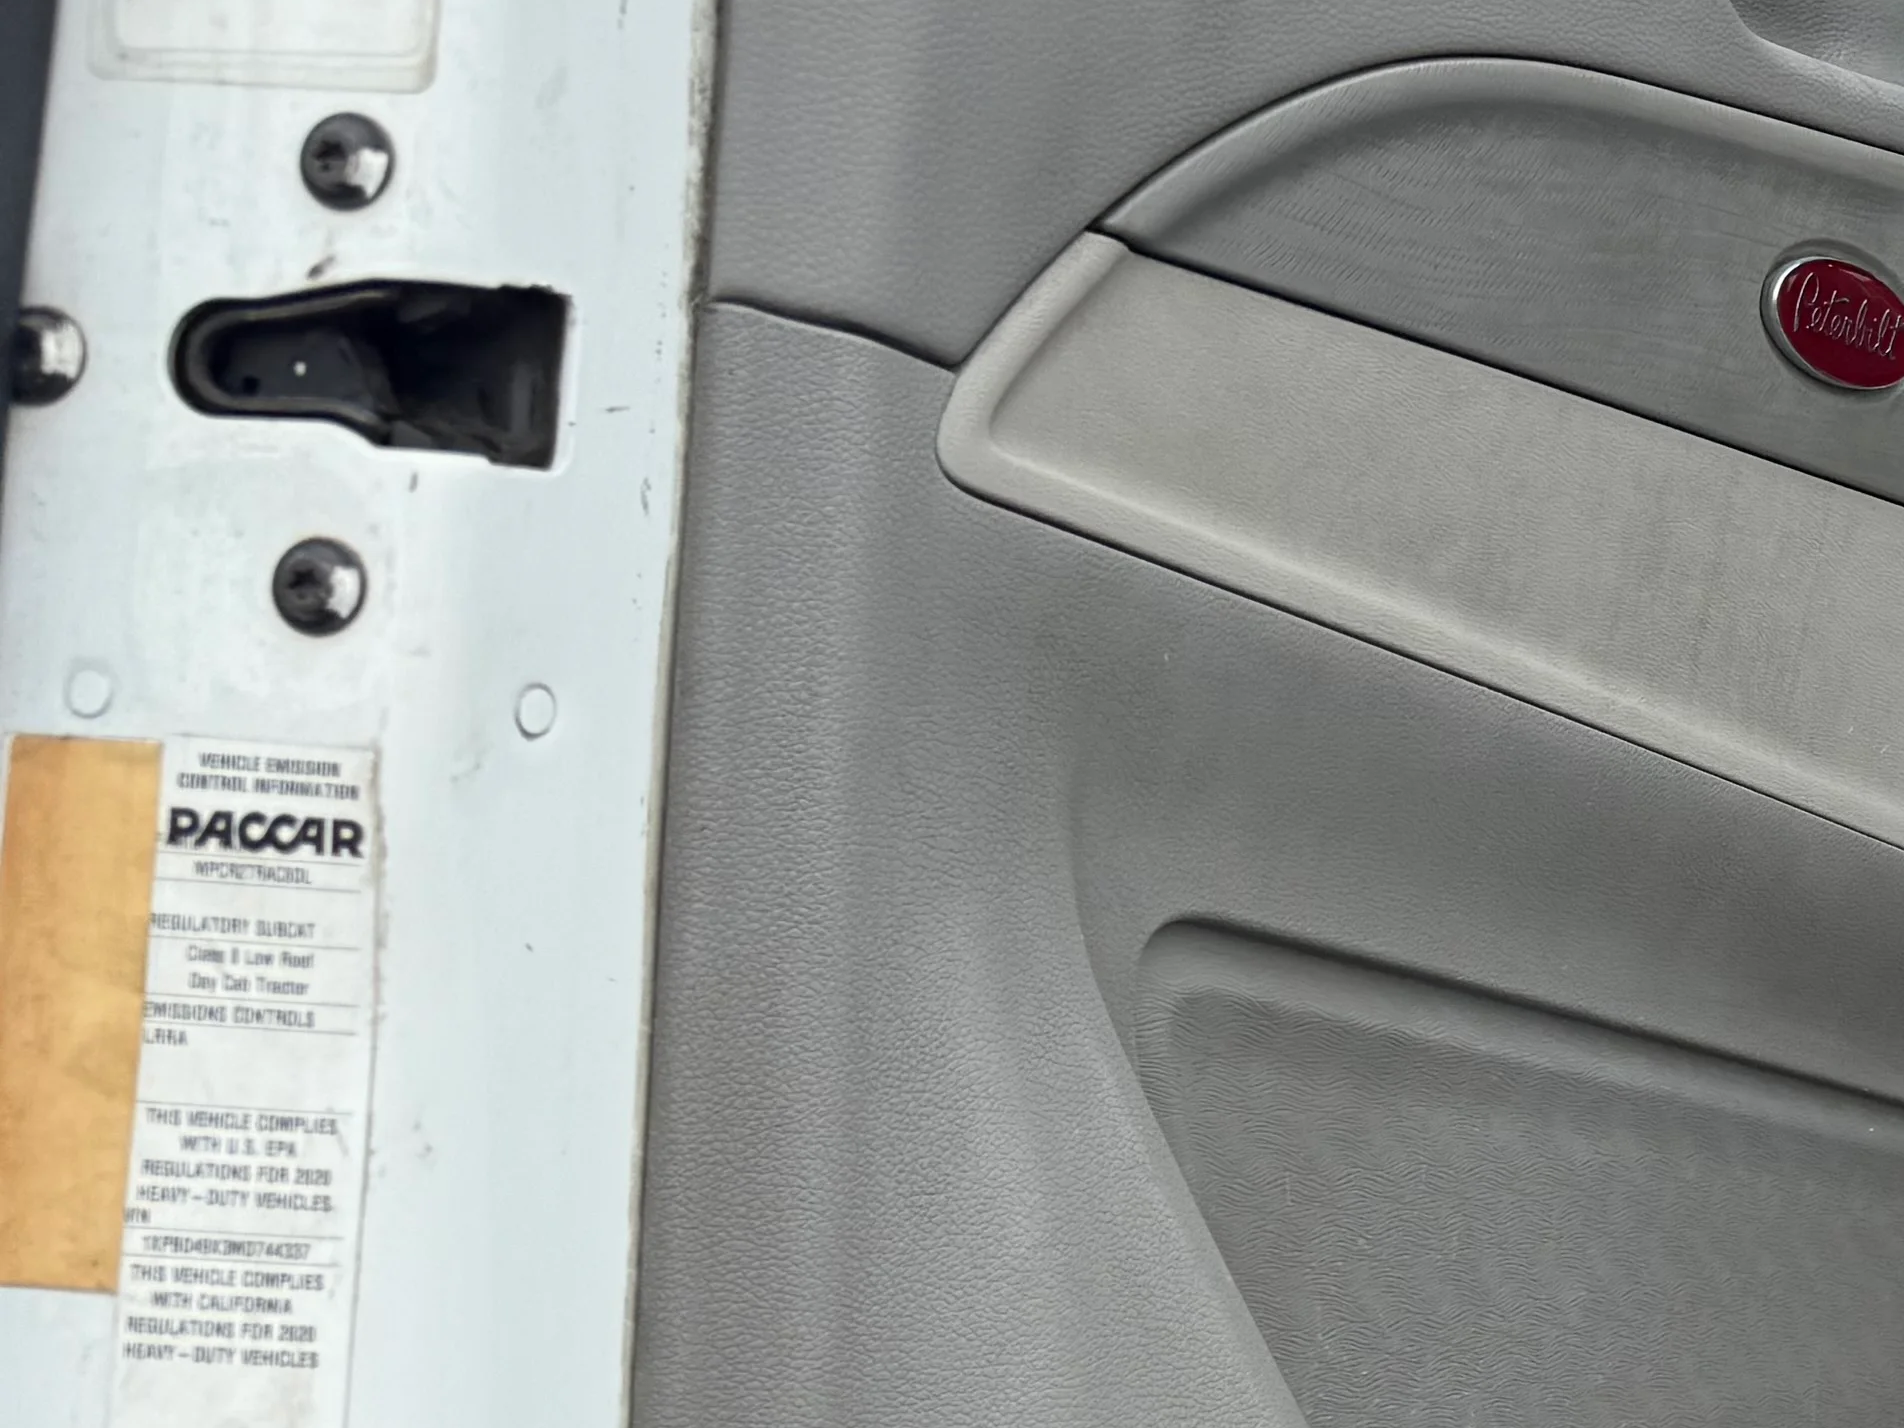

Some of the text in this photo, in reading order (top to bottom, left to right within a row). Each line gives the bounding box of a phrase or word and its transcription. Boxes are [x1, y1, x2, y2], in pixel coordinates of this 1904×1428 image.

[176, 773, 360, 799] CONTROL INFORMATION
[166, 807, 364, 858] PACCAR
[145, 1107, 337, 1135] THIS VEHICLE COMPLIES
[180, 1135, 221, 1152] WITH
[265, 1140, 298, 1157] EPA
[141, 1159, 251, 1181] REGULATIONS
[256, 1165, 289, 1183] FOR
[255, 1192, 333, 1212] VEHICLES
[130, 1263, 324, 1291] THIS VEHICLE COMPLIES
[151, 1291, 292, 1315] WITH CALIFORNIA
[126, 1315, 235, 1338] REGULATIONS
[240, 1322, 274, 1339] FOR
[241, 1349, 319, 1368] VEHICLES
